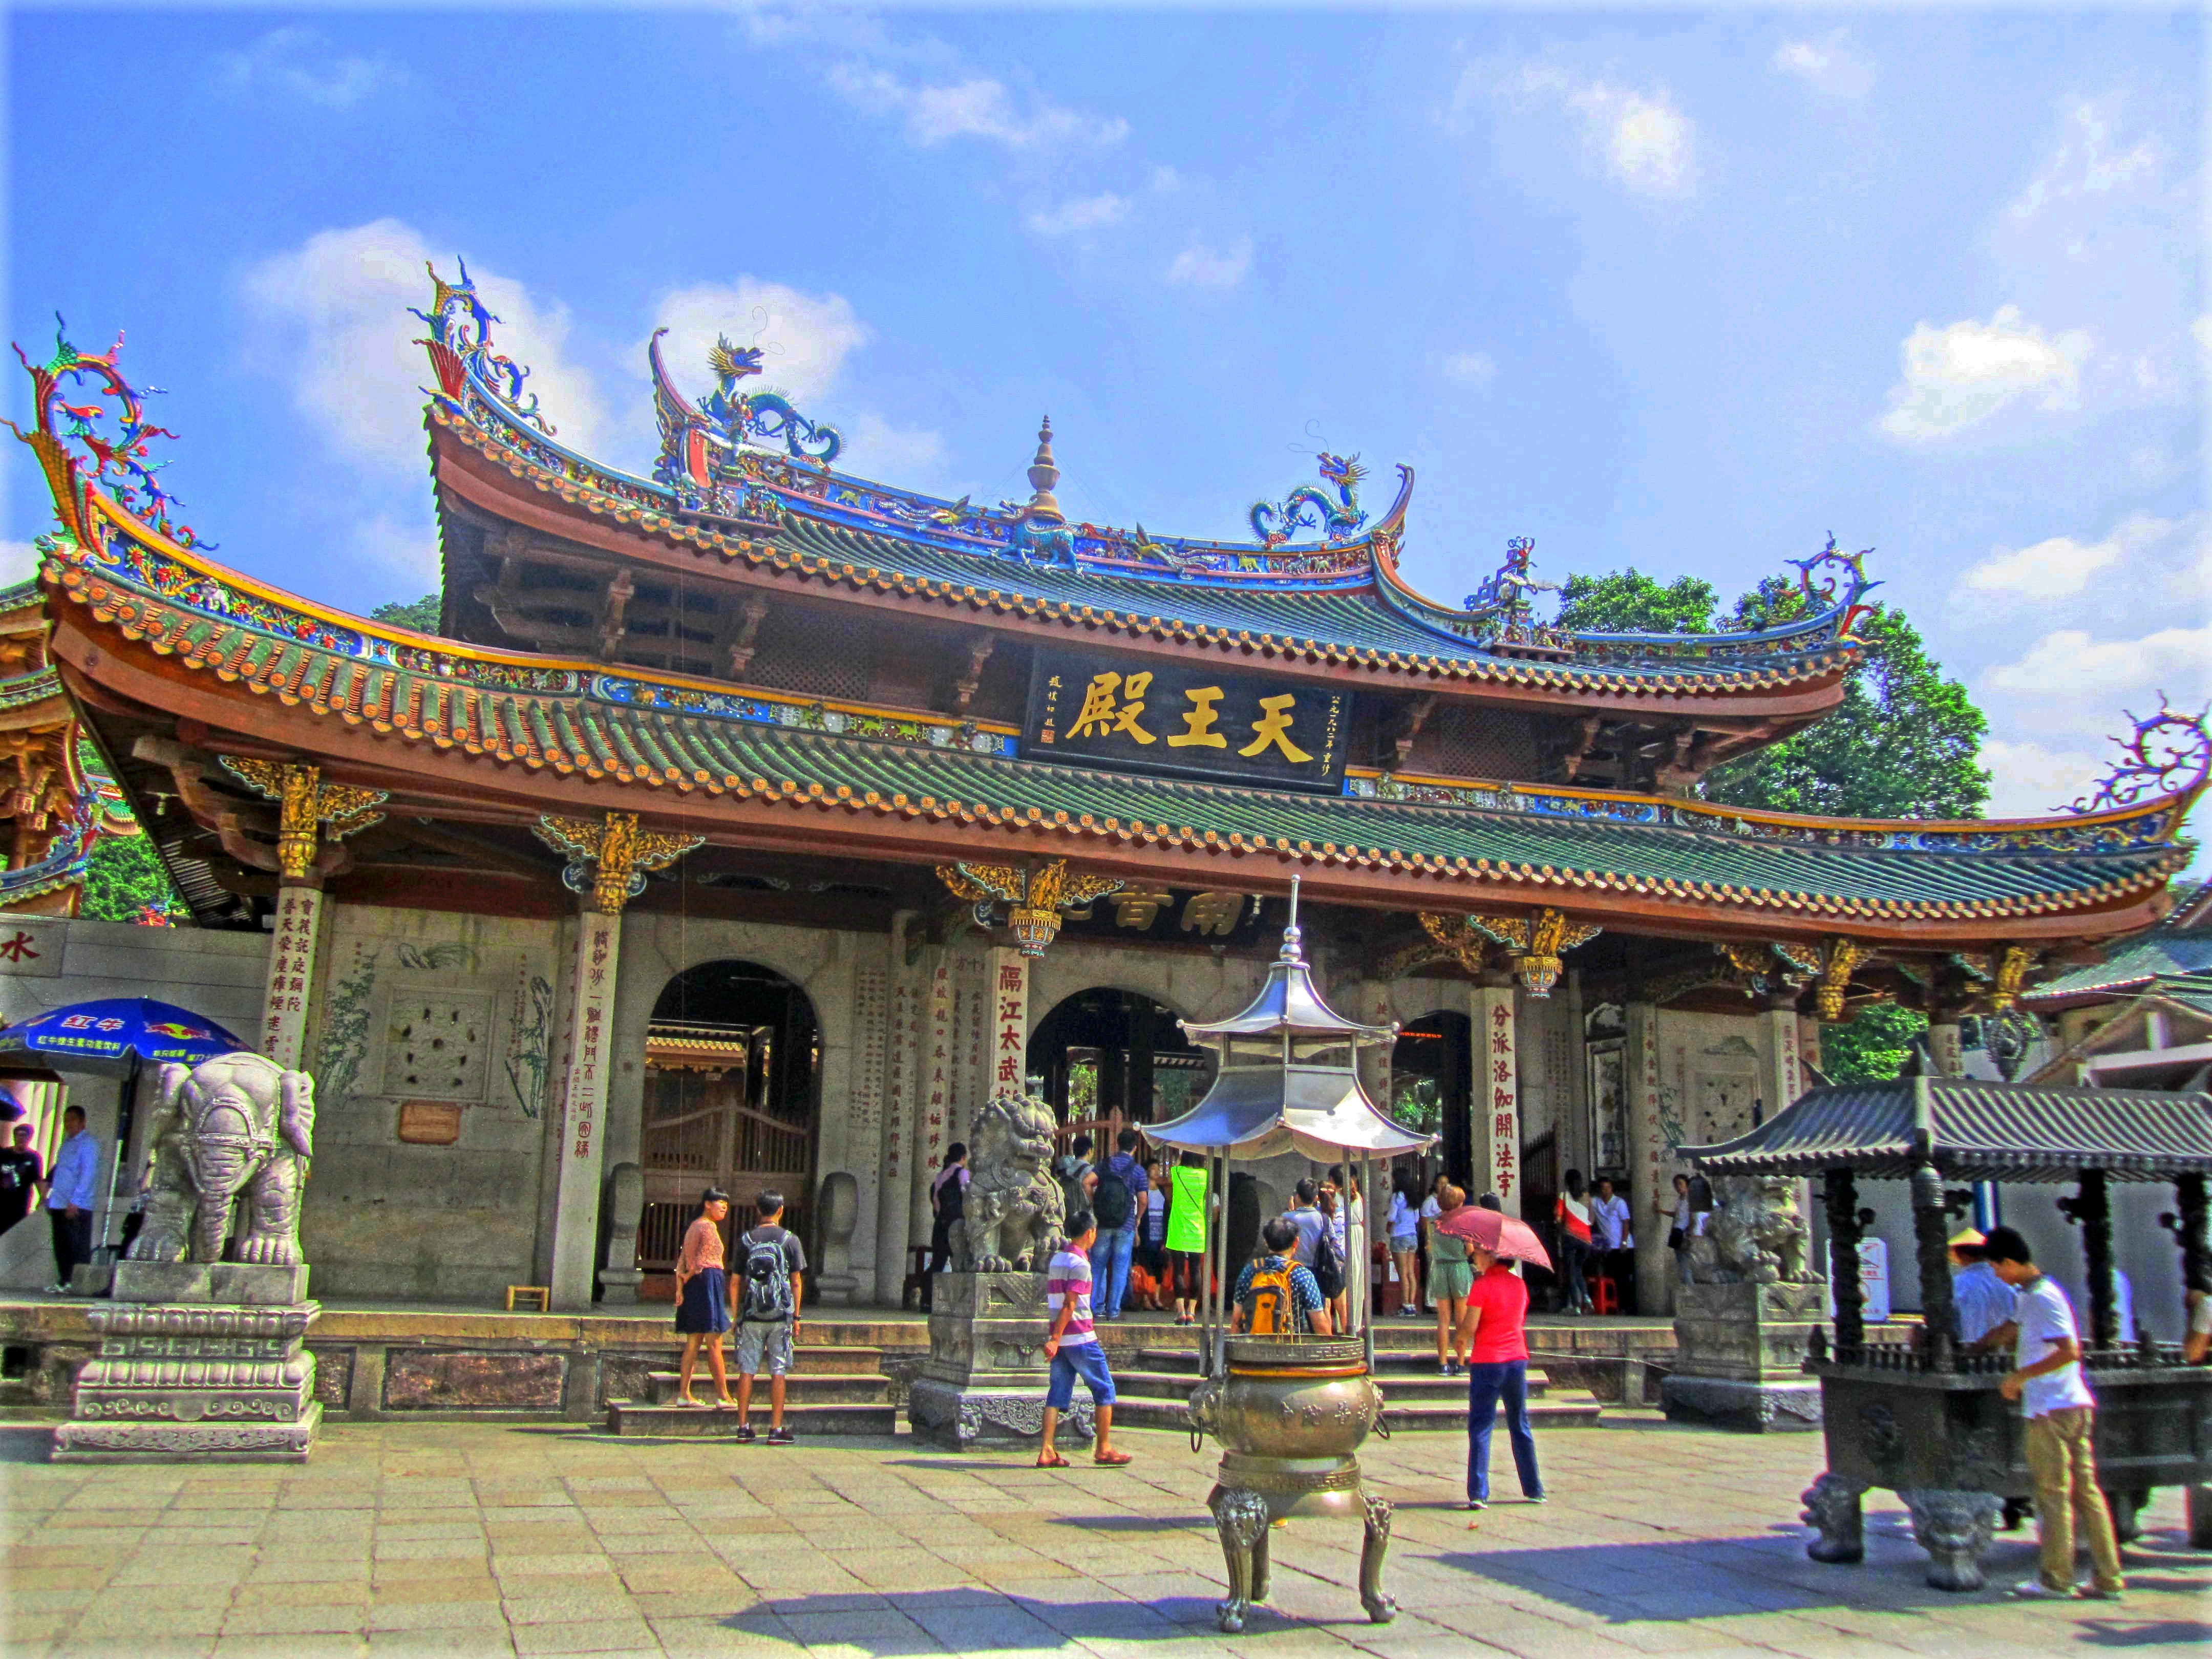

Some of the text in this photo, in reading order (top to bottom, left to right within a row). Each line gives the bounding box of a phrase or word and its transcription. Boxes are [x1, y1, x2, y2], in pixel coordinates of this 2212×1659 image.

[61, 1014, 125, 1031] 红牛
[995, 966, 1023, 1098] 隔江太武
